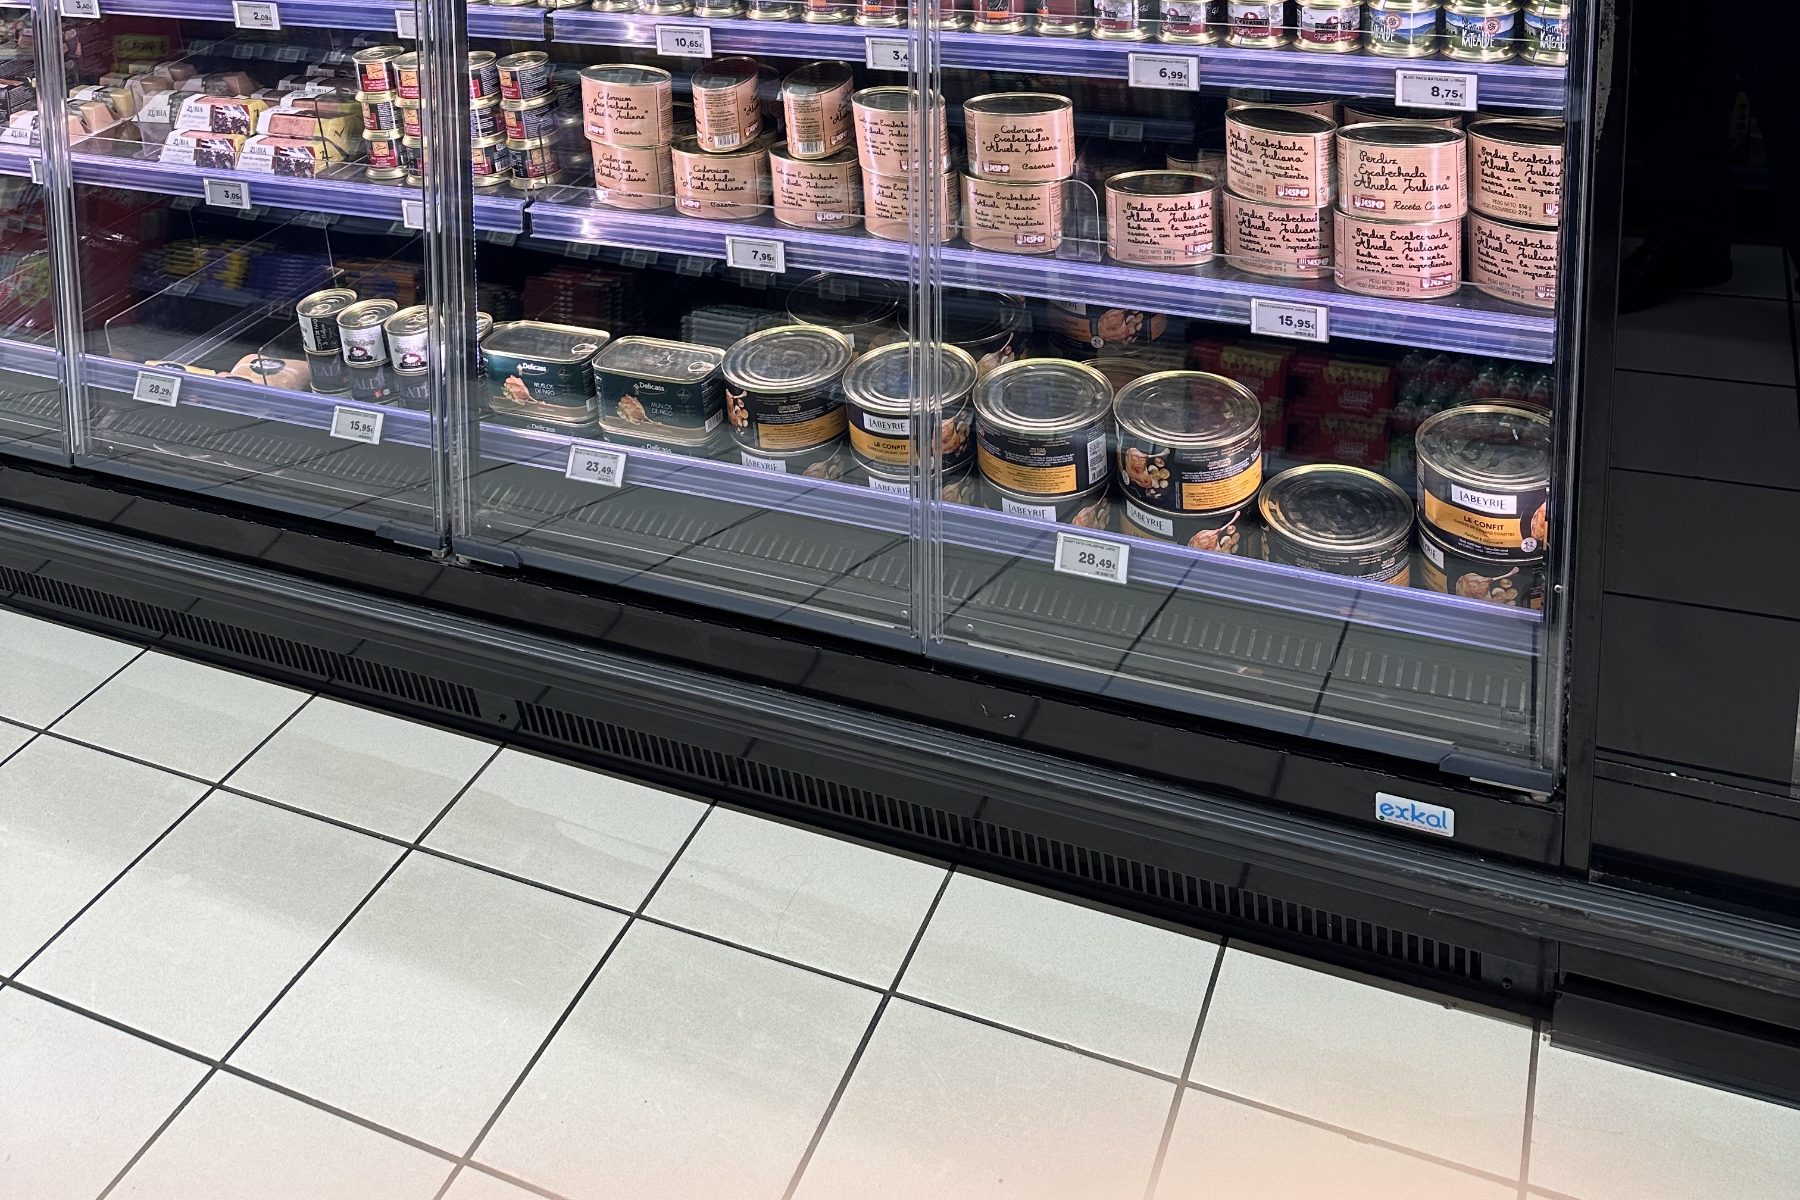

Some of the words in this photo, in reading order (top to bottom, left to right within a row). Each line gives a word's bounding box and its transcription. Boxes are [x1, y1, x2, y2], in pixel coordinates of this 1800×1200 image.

[674, 37, 703, 49] 10,65€
[1461, 28, 1495, 49] KATEALDE
[1540, 28, 1567, 51] KATEAL
[1159, 67, 1187, 80] 6,99€
[1431, 85, 1464, 100] 8,75€
[1250, 135, 1305, 152] Escabechada
[1359, 149, 1399, 165] Perdiz
[1481, 146, 1509, 161] Perdiz
[1512, 151, 1561, 165] Escabecha
[1265, 169, 1309, 180] ingredientes
[1358, 163, 1427, 178] Escabechada
[1528, 176, 1538, 185] la
[1284, 187, 1309, 198] JESPEP
[1126, 201, 1153, 212] Perdiz
[1156, 199, 1210, 213] Escabechda
[1361, 198, 1385, 209] JESPEP
[1393, 200, 1423, 211] Receta
[1238, 207, 1265, 221] Perdiz
[1356, 227, 1386, 240] Perdiz
[1477, 225, 1501, 242] Perdiz
[1504, 233, 1554, 250] Escabecha
[751, 250, 775, 262] 7,95€
[1405, 253, 1415, 262] la
[1277, 314, 1316, 330] 15,95€
[522, 362, 547, 373] Delicass
[639, 382, 665, 392] Delicass
[531, 423, 556, 433] Delicass
[869, 418, 906, 432] LABEYRIE
[881, 443, 907, 451] CONFIT
[585, 460, 615, 477] 23,49€
[1459, 490, 1508, 510] LABEYRIE
[1007, 503, 1046, 519] LABEYRIE
[1130, 505, 1164, 531] LABEYRIE
[1463, 515, 1472, 523] LE
[1474, 519, 1505, 531] CONFIT
[1078, 551, 1117, 571] 28,49€
[1379, 802, 1448, 830] exkal
